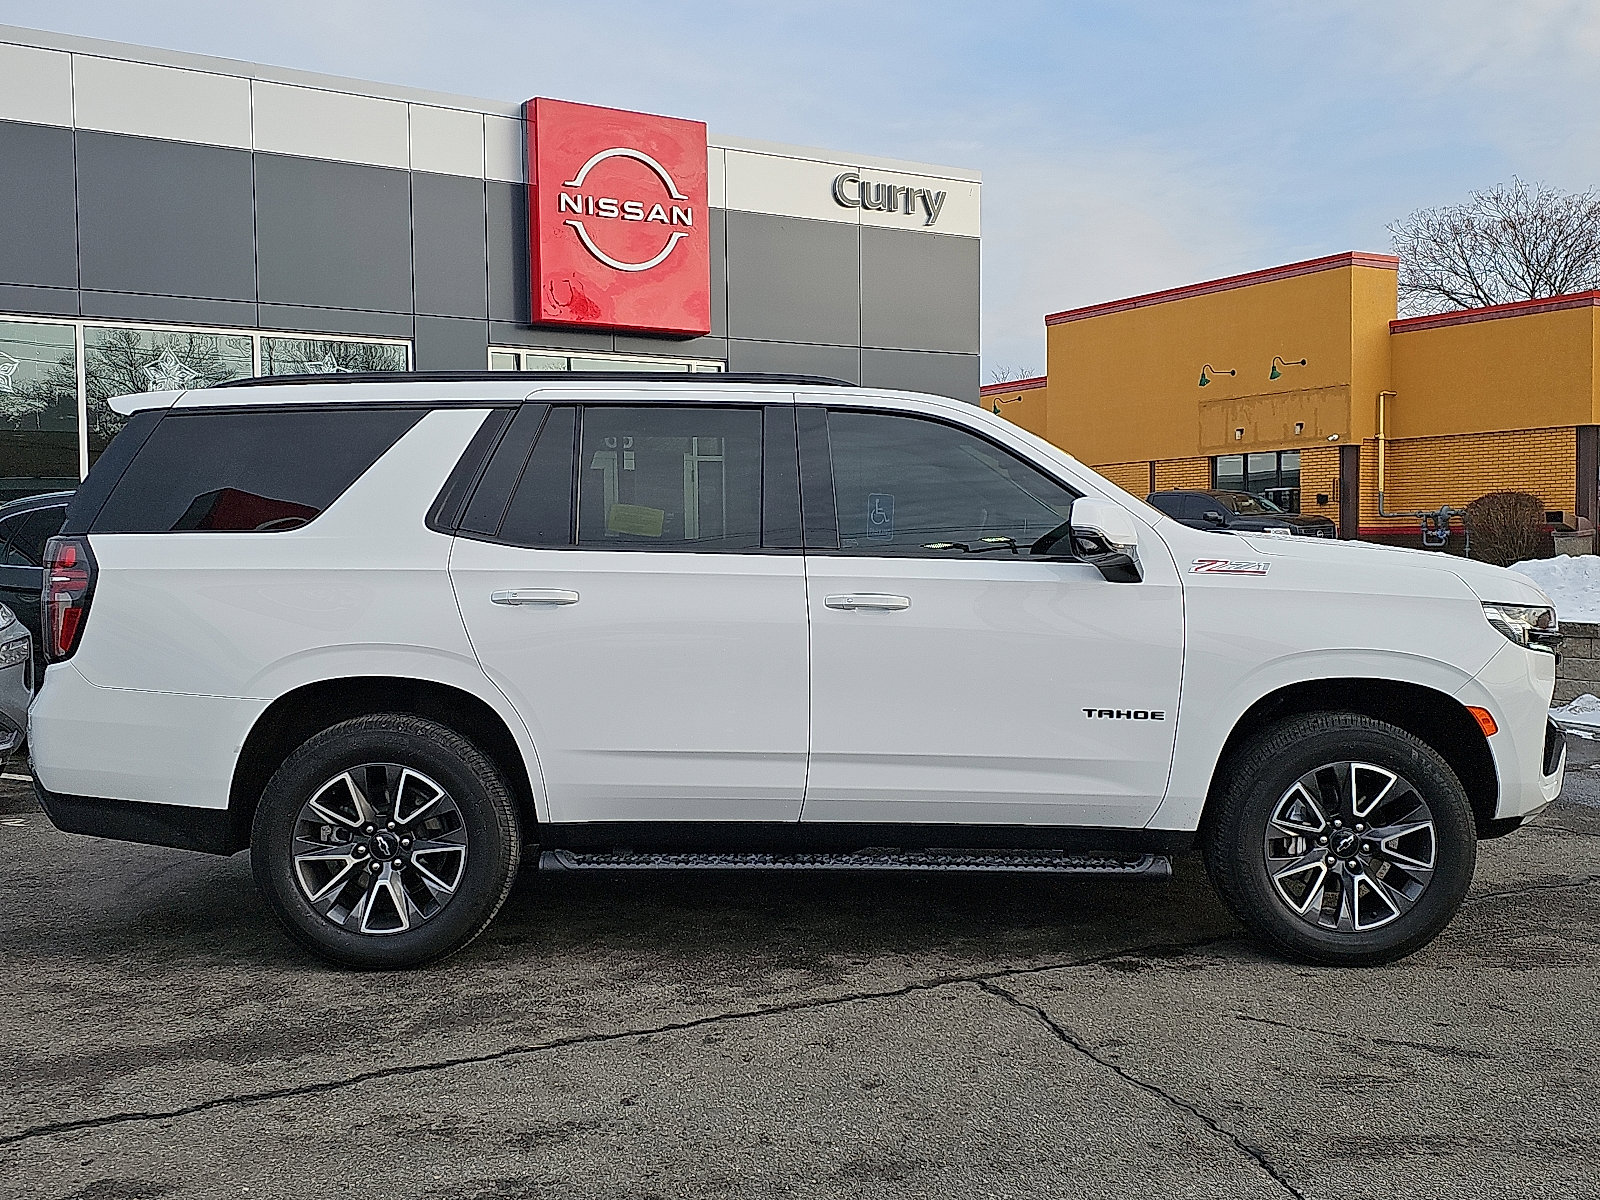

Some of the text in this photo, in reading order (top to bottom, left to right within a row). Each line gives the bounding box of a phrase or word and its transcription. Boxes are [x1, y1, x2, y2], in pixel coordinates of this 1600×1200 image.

[558, 192, 693, 226] NISSAN
[832, 173, 947, 226] Curry
[1082, 708, 1165, 721] TAHOE
